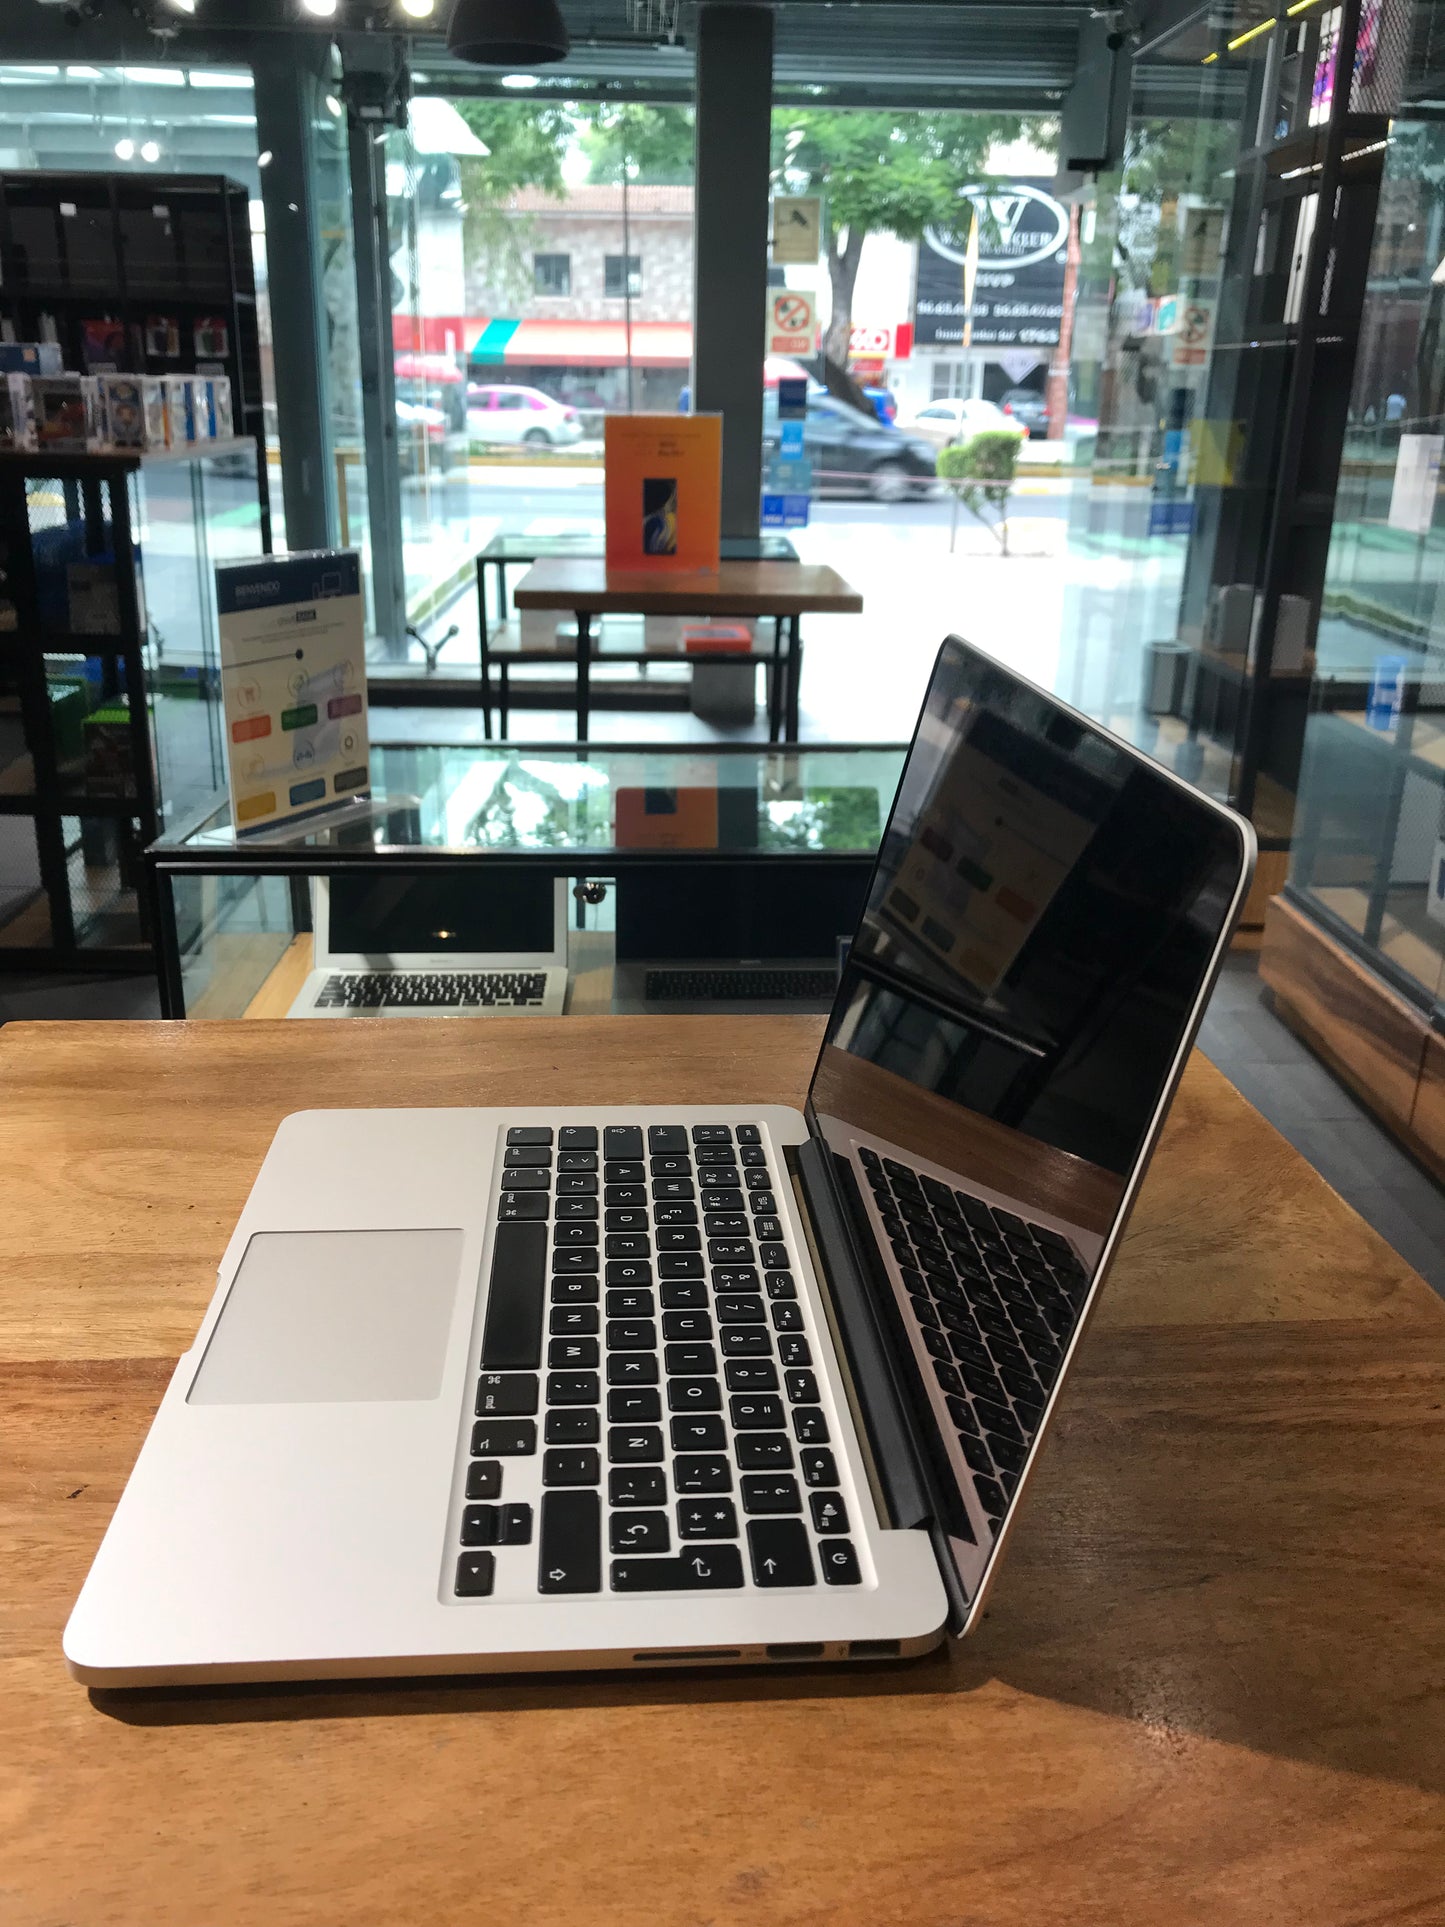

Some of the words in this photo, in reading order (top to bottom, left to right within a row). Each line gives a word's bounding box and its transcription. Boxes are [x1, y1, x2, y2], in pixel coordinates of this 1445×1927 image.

[507, 1193, 515, 1203] cmd
[734, 1245, 746, 1253] %
[622, 1268, 636, 1276] G
[567, 1314, 581, 1322] N
[680, 1320, 694, 1328] U
[566, 1346, 581, 1356] M
[625, 1363, 640, 1371] K
[687, 1387, 702, 1397] O
[485, 1395, 496, 1409] cmd
[740, 1406, 755, 1414] 0
[690, 1427, 706, 1435] P
[628, 1438, 648, 1447] Ñ
[690, 1513, 702, 1521] +
[627, 1525, 648, 1535] Ç
